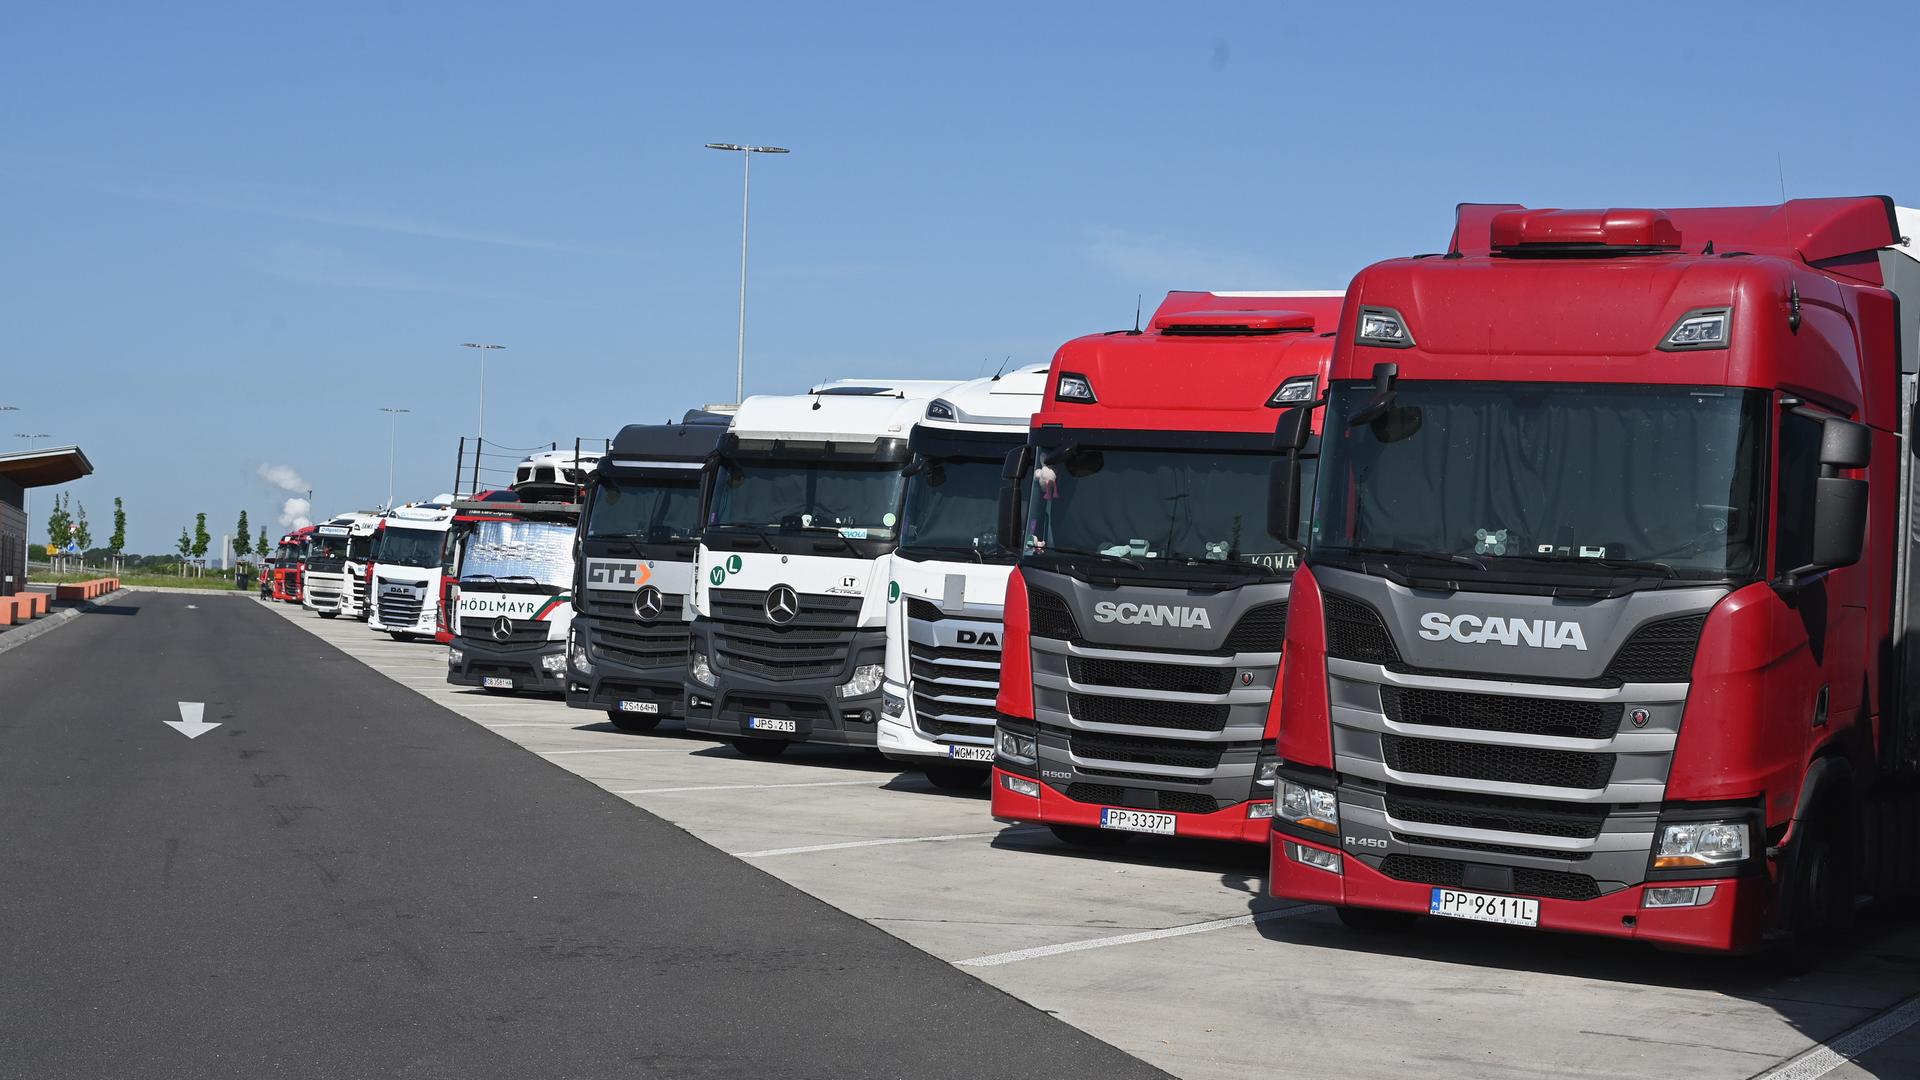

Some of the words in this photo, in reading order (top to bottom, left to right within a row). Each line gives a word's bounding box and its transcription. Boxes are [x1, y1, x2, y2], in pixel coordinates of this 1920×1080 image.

[587, 562, 637, 584] GTI
[843, 577, 856, 587] LT
[460, 597, 535, 613] HÖDLMAYR
[1093, 601, 1212, 630] SCANIA
[956, 629, 1001, 646] DA
[1418, 612, 1588, 651] SCANIA
[755, 719, 774, 730] JPS
[778, 720, 794, 731] 215
[1109, 811, 1127, 825] PP
[1131, 813, 1172, 830] 3337P
[1443, 892, 1468, 911] PP
[1475, 896, 1532, 920] 9611L
